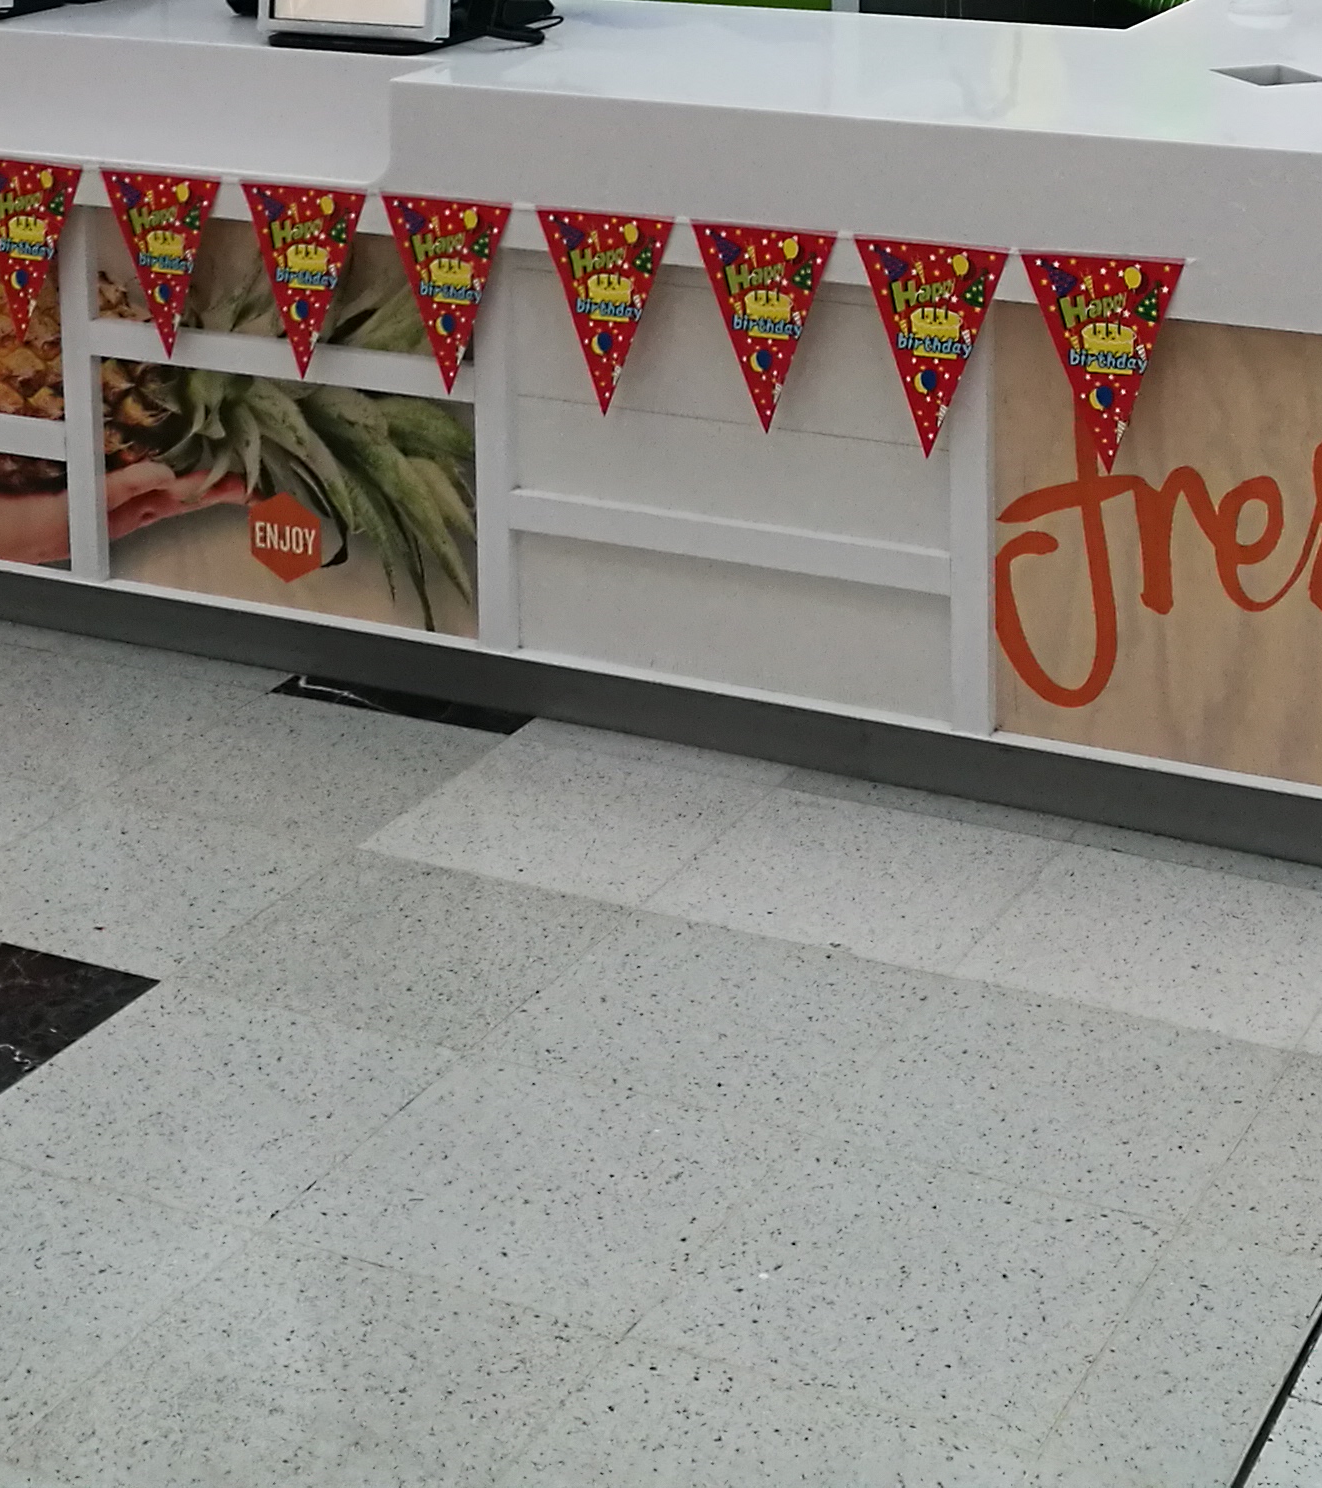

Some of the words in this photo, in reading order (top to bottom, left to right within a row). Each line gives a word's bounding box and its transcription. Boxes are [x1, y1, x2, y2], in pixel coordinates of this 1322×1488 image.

[411, 230, 466, 264] Happy
[138, 252, 194, 275] birthday
[568, 245, 627, 279] Happy
[276, 265, 338, 290] birthday
[724, 262, 786, 296] Happy
[419, 280, 483, 304] birthday
[890, 277, 955, 313] Happy
[576, 297, 642, 322] birthday
[1059, 292, 1127, 329] Happy
[732, 314, 803, 340] birthday
[896, 332, 974, 359] birthday
[1068, 348, 1149, 374] birthday
[255, 520, 316, 555] ENJOY
